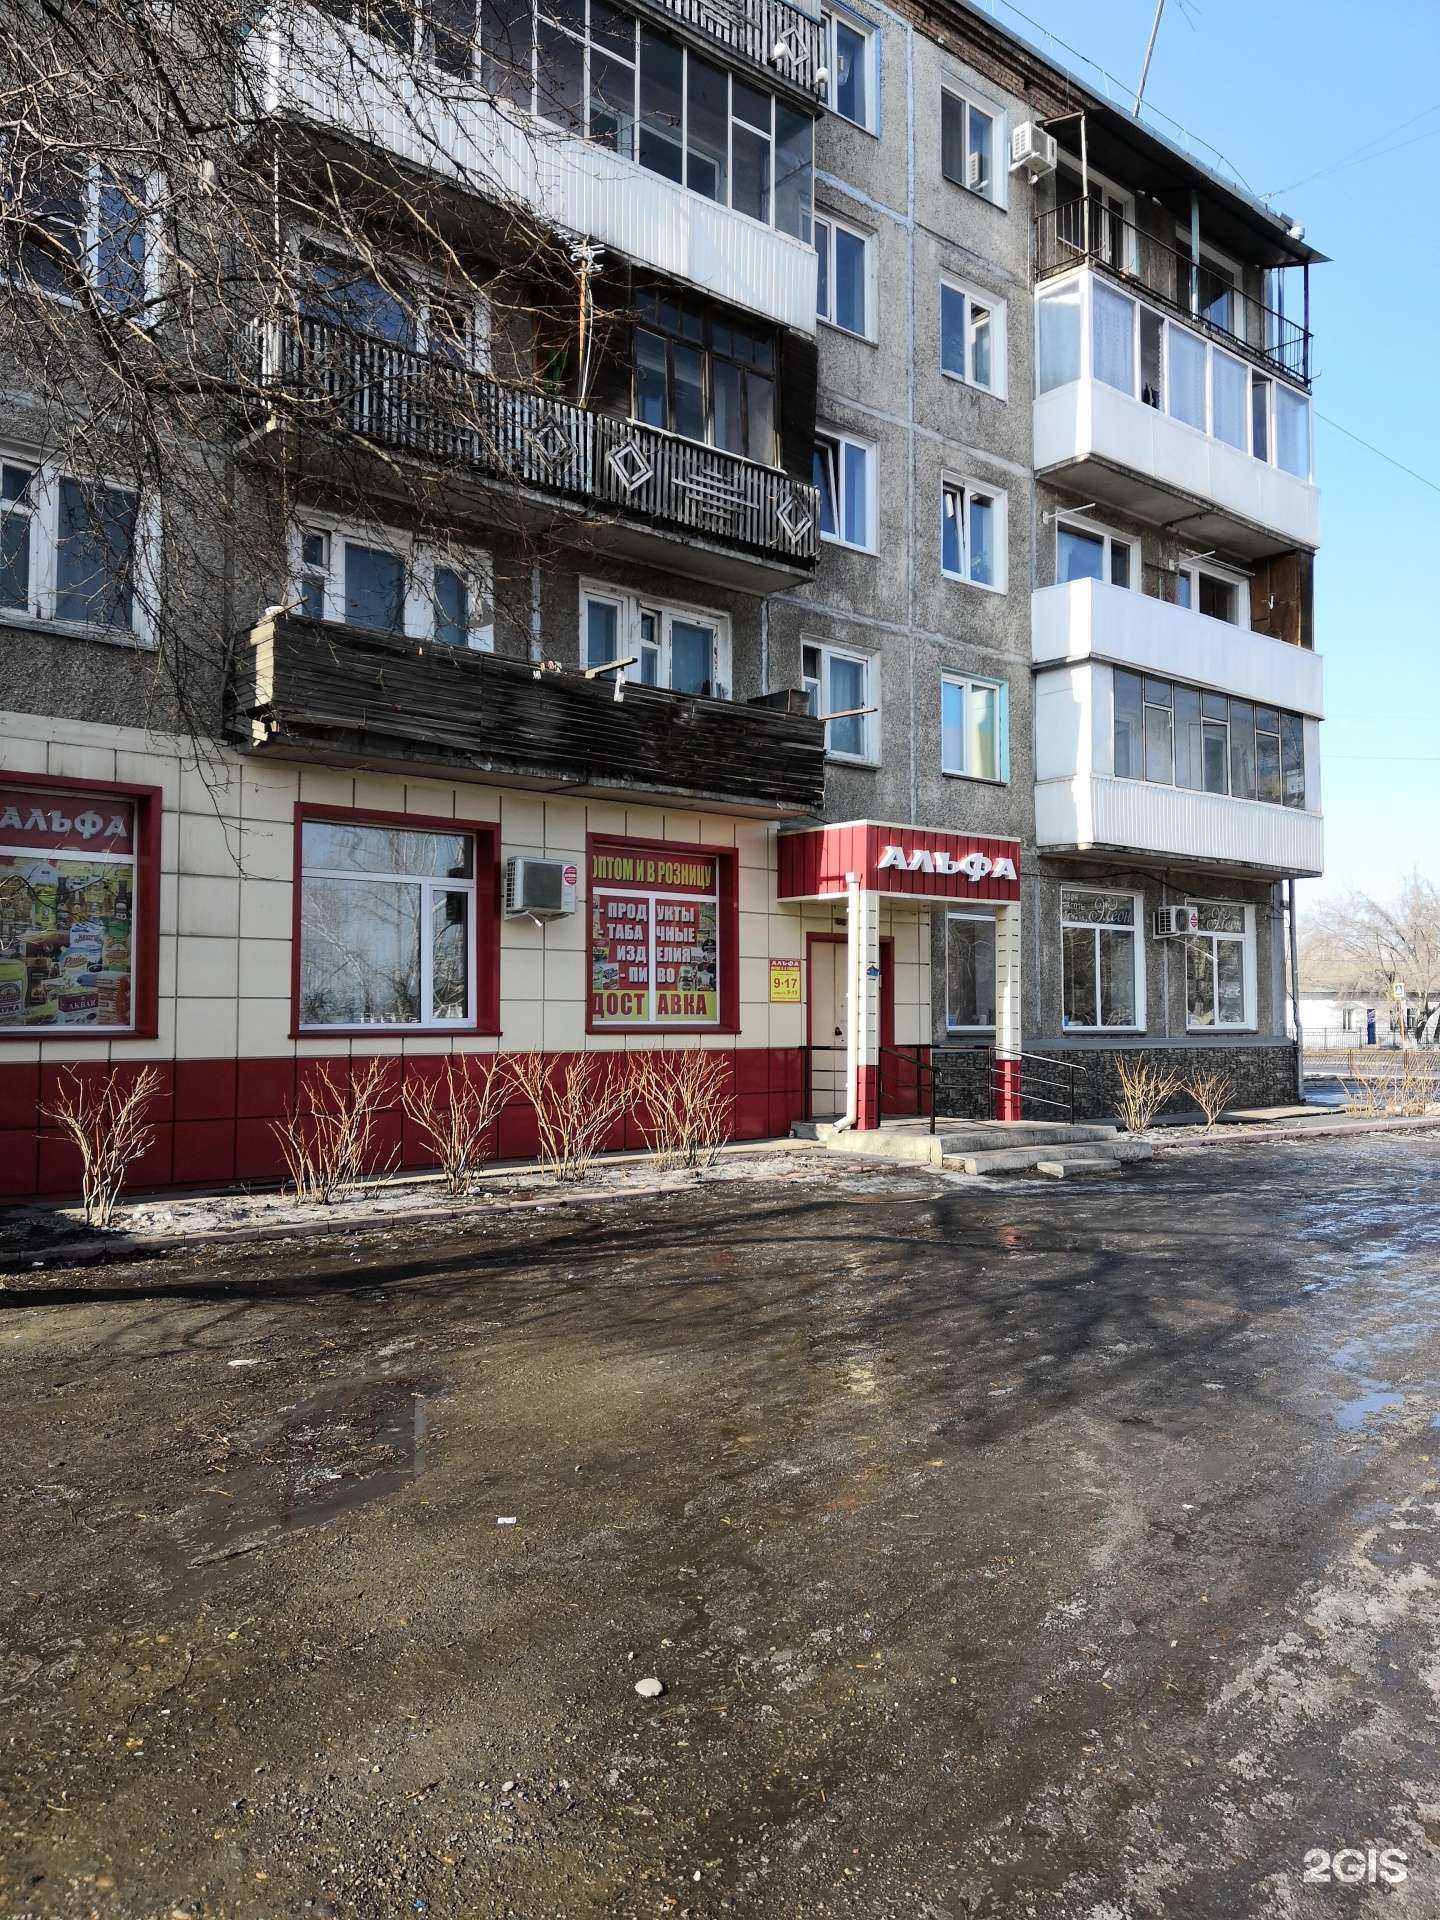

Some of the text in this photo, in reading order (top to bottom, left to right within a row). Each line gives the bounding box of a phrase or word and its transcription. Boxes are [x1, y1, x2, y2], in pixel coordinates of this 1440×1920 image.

[0, 806, 128, 840] АЛЬФА
[636, 858, 645, 882] И
[649, 859, 656, 883] В
[657, 861, 712, 890] РОЗНИЦУ
[877, 845, 1018, 882] АЛЬФА
